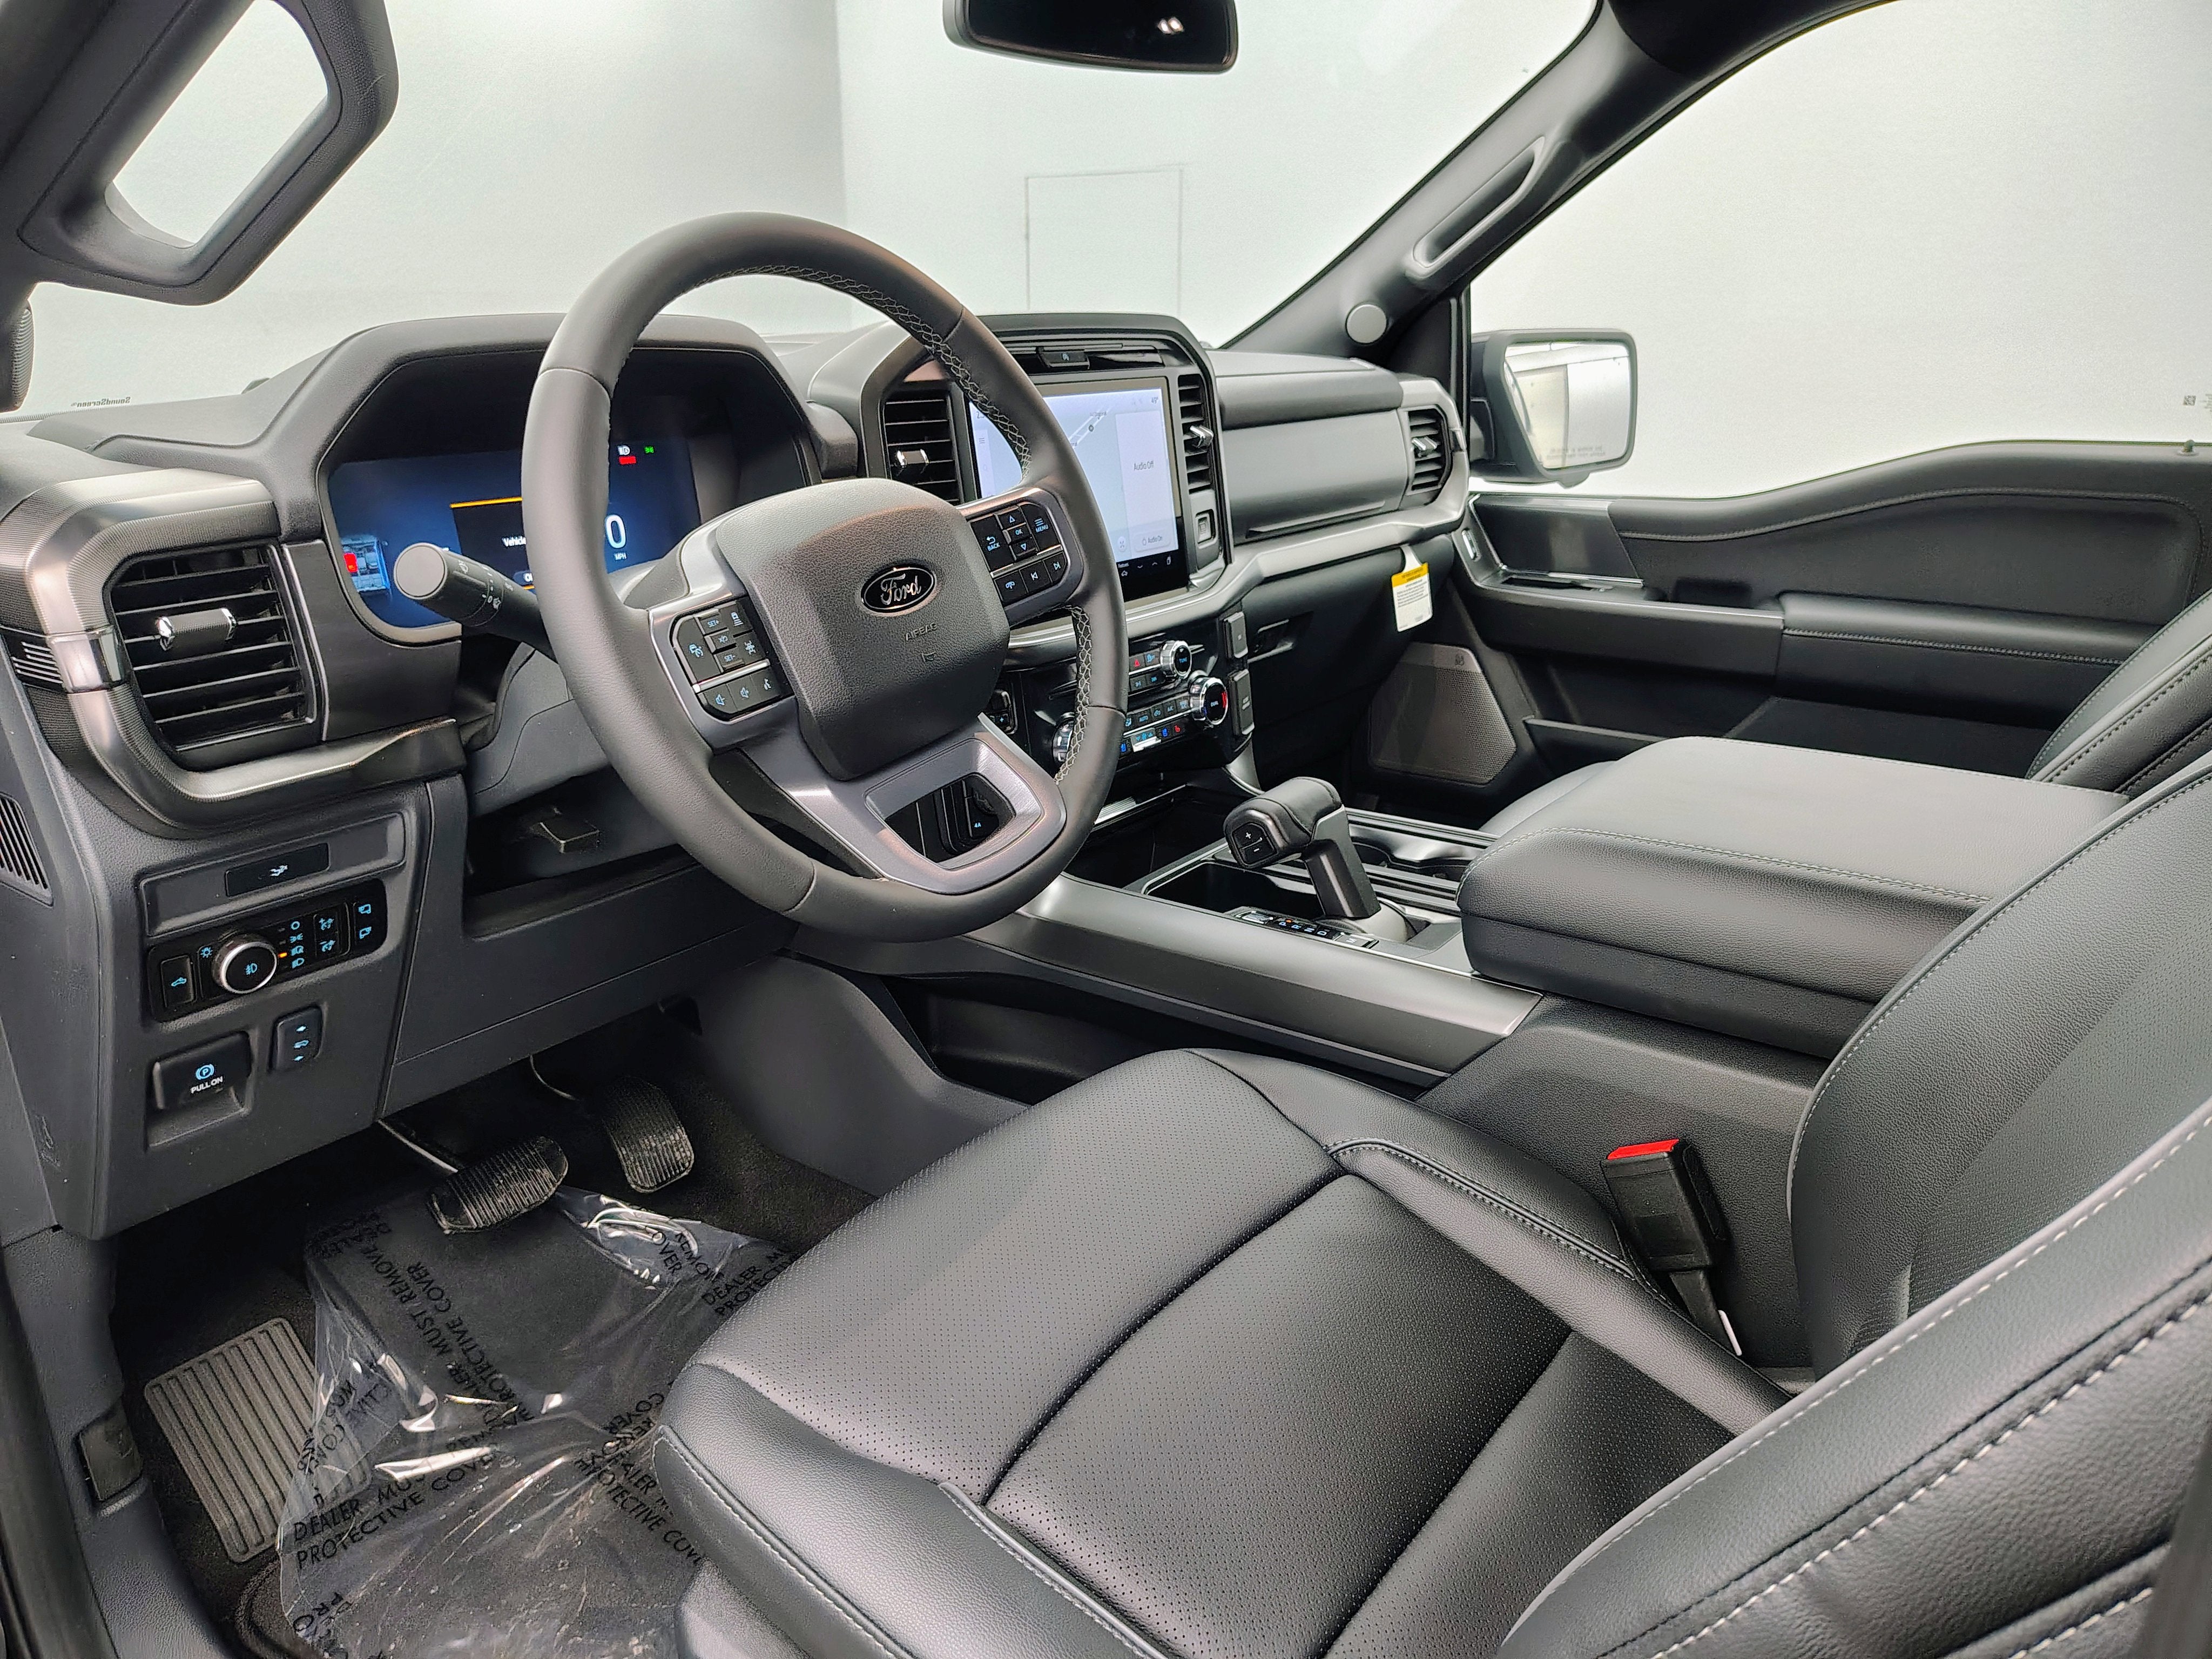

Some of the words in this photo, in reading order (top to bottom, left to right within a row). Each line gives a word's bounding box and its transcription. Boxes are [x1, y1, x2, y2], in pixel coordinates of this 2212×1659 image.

[1134, 462, 1147, 471] Audio
[605, 514, 626, 549] 0
[987, 542, 1001, 551] BACK
[1035, 524, 1049, 533] MENU
[880, 573, 922, 605] Ford
[191, 1082, 211, 1094] PULL
[211, 1076, 223, 1086] ON
[407, 1260, 451, 1313] COVER
[702, 1265, 762, 1306] DEALER
[411, 1310, 452, 1356] MUST
[446, 1316, 516, 1401] ROTECTIVE
[293, 1498, 361, 1543] DEALER
[297, 1491, 426, 1570] PROTECTIVE
[431, 1453, 494, 1492] COVE
